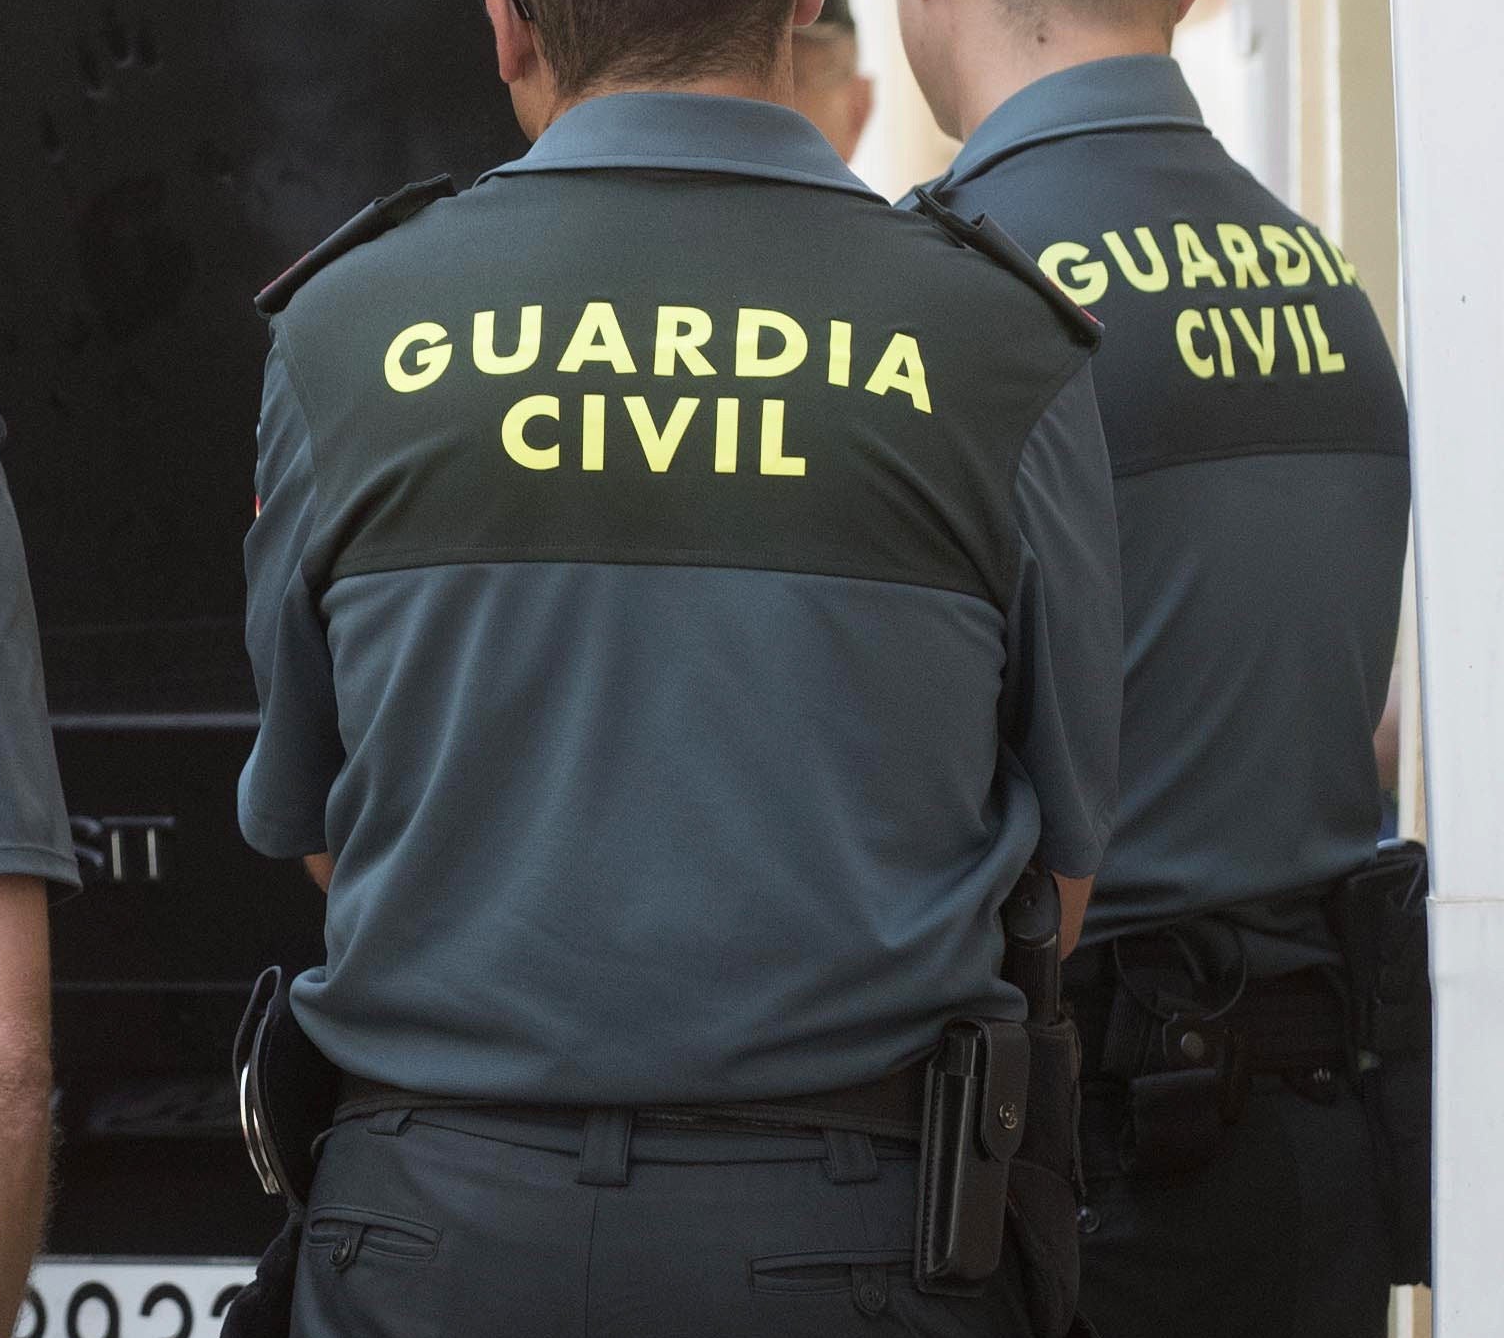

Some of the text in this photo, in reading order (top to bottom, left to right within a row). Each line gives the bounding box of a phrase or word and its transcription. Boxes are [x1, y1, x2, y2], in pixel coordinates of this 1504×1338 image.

[384, 301, 932, 414] GUARDIA
[1175, 304, 1345, 379] CIVIL
[501, 394, 806, 477] CIVIL
